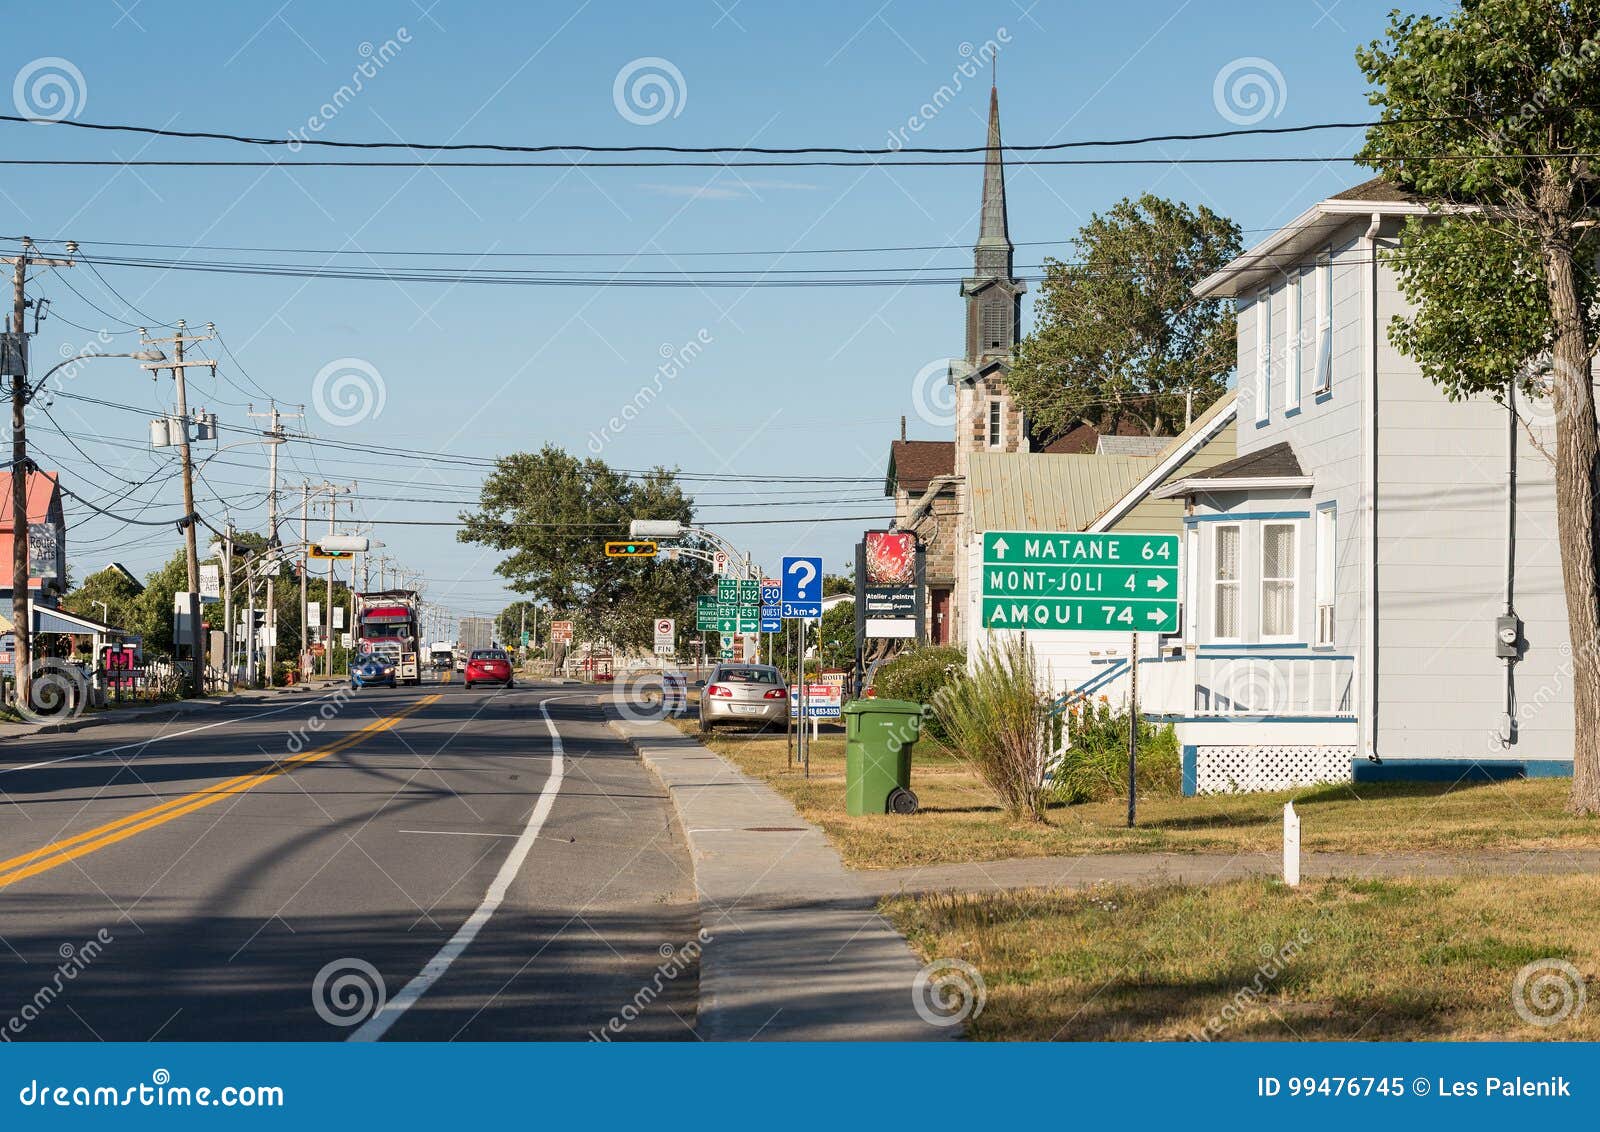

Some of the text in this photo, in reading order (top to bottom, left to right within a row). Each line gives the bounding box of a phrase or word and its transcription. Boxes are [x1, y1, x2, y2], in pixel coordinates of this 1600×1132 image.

[30, 536, 55, 548] Route
[37, 549, 56, 560] Arts
[1024, 539, 1170, 560] MATANE 64
[990, 571, 1136, 592] MONT-JOLI 4
[720, 589, 736, 600] 132
[742, 590, 758, 600] 132
[764, 588, 780, 599] 20
[720, 608, 735, 616] EST
[742, 609, 757, 617] EST
[762, 608, 780, 616] OUEST
[784, 604, 792, 615] 3
[990, 604, 1134, 625] AMQUI 74
